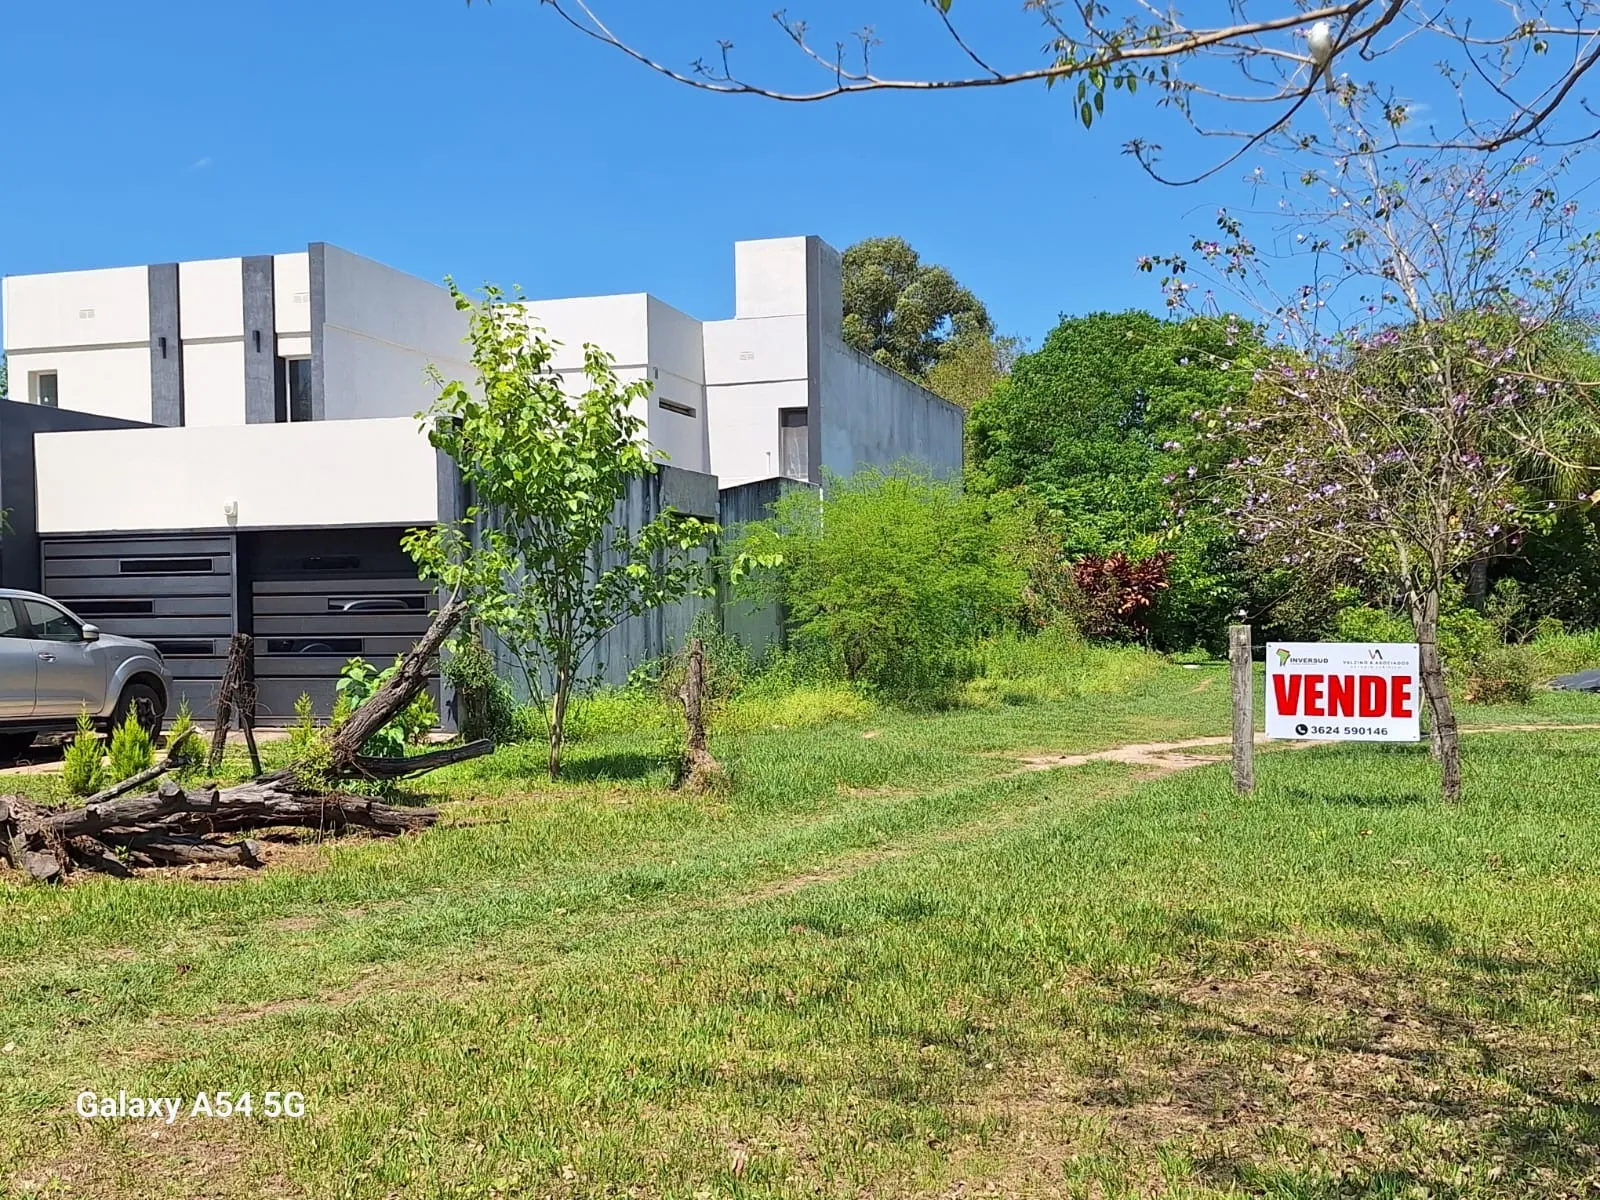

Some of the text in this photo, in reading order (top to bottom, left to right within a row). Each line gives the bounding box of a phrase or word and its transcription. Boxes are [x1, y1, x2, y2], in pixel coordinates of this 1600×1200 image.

[1272, 674, 1412, 718] VENDE
[1311, 726, 1388, 736] 3624 590146
